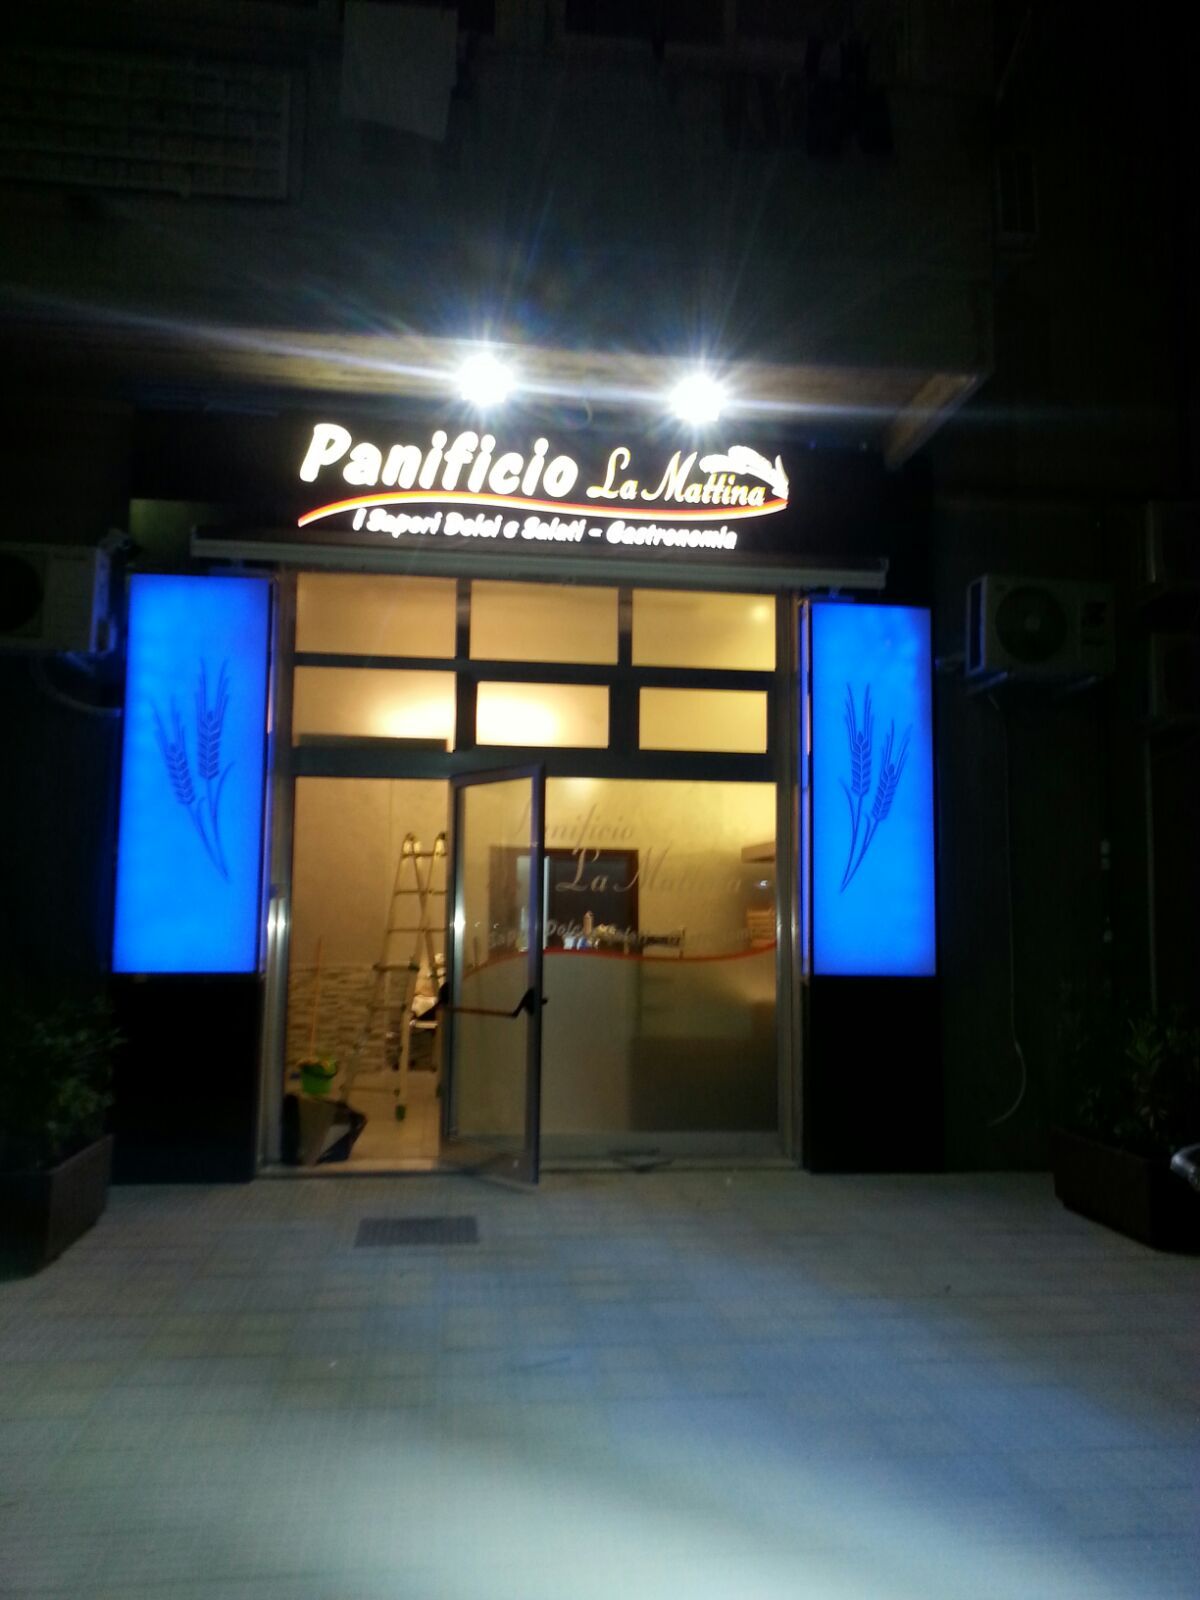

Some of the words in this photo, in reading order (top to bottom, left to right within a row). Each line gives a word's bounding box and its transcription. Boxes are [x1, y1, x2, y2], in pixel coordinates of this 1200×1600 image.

[299, 423, 578, 498] Panificio
[586, 446, 638, 501] La
[640, 449, 766, 506] Mattina
[366, 508, 443, 539] Sapori
[443, 511, 504, 539] Dolci
[502, 519, 519, 540] e
[521, 515, 587, 543] Salati
[605, 520, 739, 551] Gastronomia
